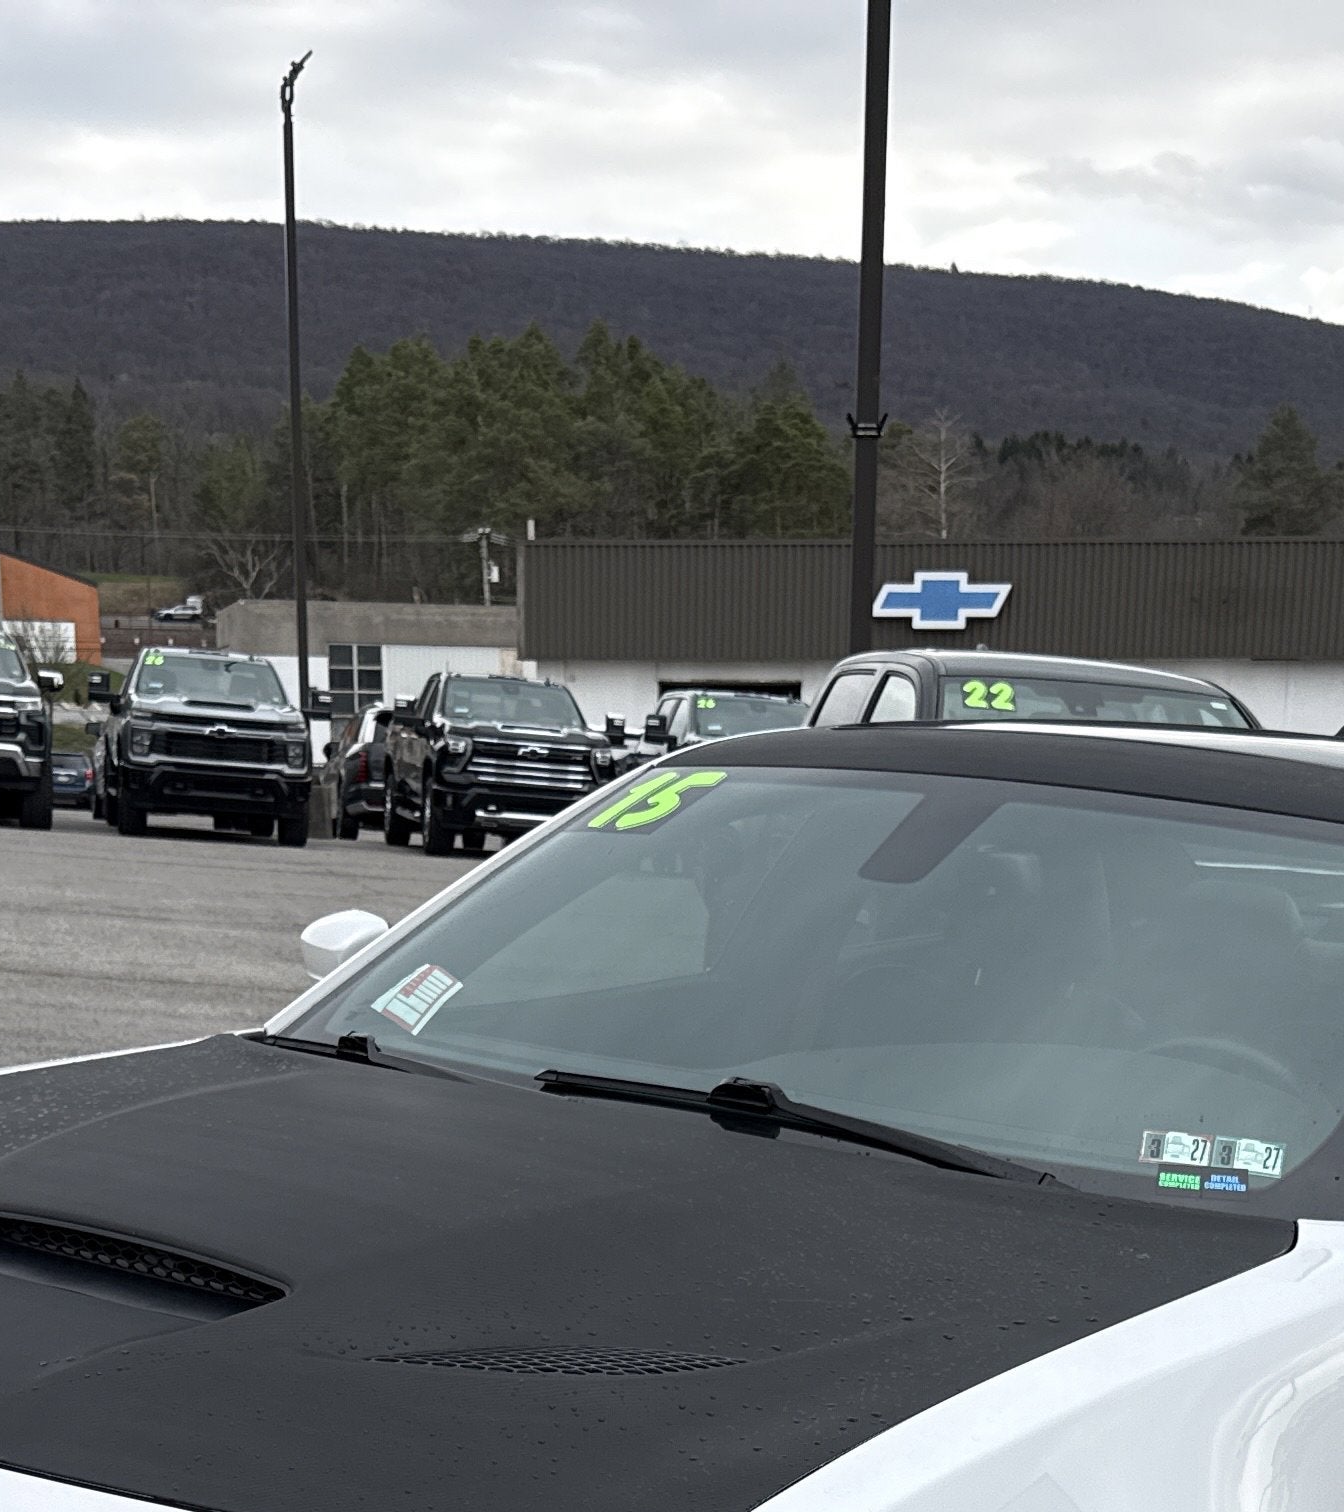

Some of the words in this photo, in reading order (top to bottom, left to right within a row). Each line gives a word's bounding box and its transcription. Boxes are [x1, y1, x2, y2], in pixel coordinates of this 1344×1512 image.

[962, 680, 1016, 711] 22
[697, 698, 716, 709] 26
[587, 771, 728, 831] 15
[1149, 1138, 1162, 1159] 3
[1190, 1138, 1208, 1164] 27
[1221, 1145, 1233, 1166] 3
[1263, 1146, 1281, 1172] 27
[1159, 1172, 1201, 1183] SERVICE
[1210, 1174, 1240, 1184] DETAIL
[1158, 1180, 1201, 1191] COMPLETED
[1204, 1181, 1247, 1192] COMPLETED
